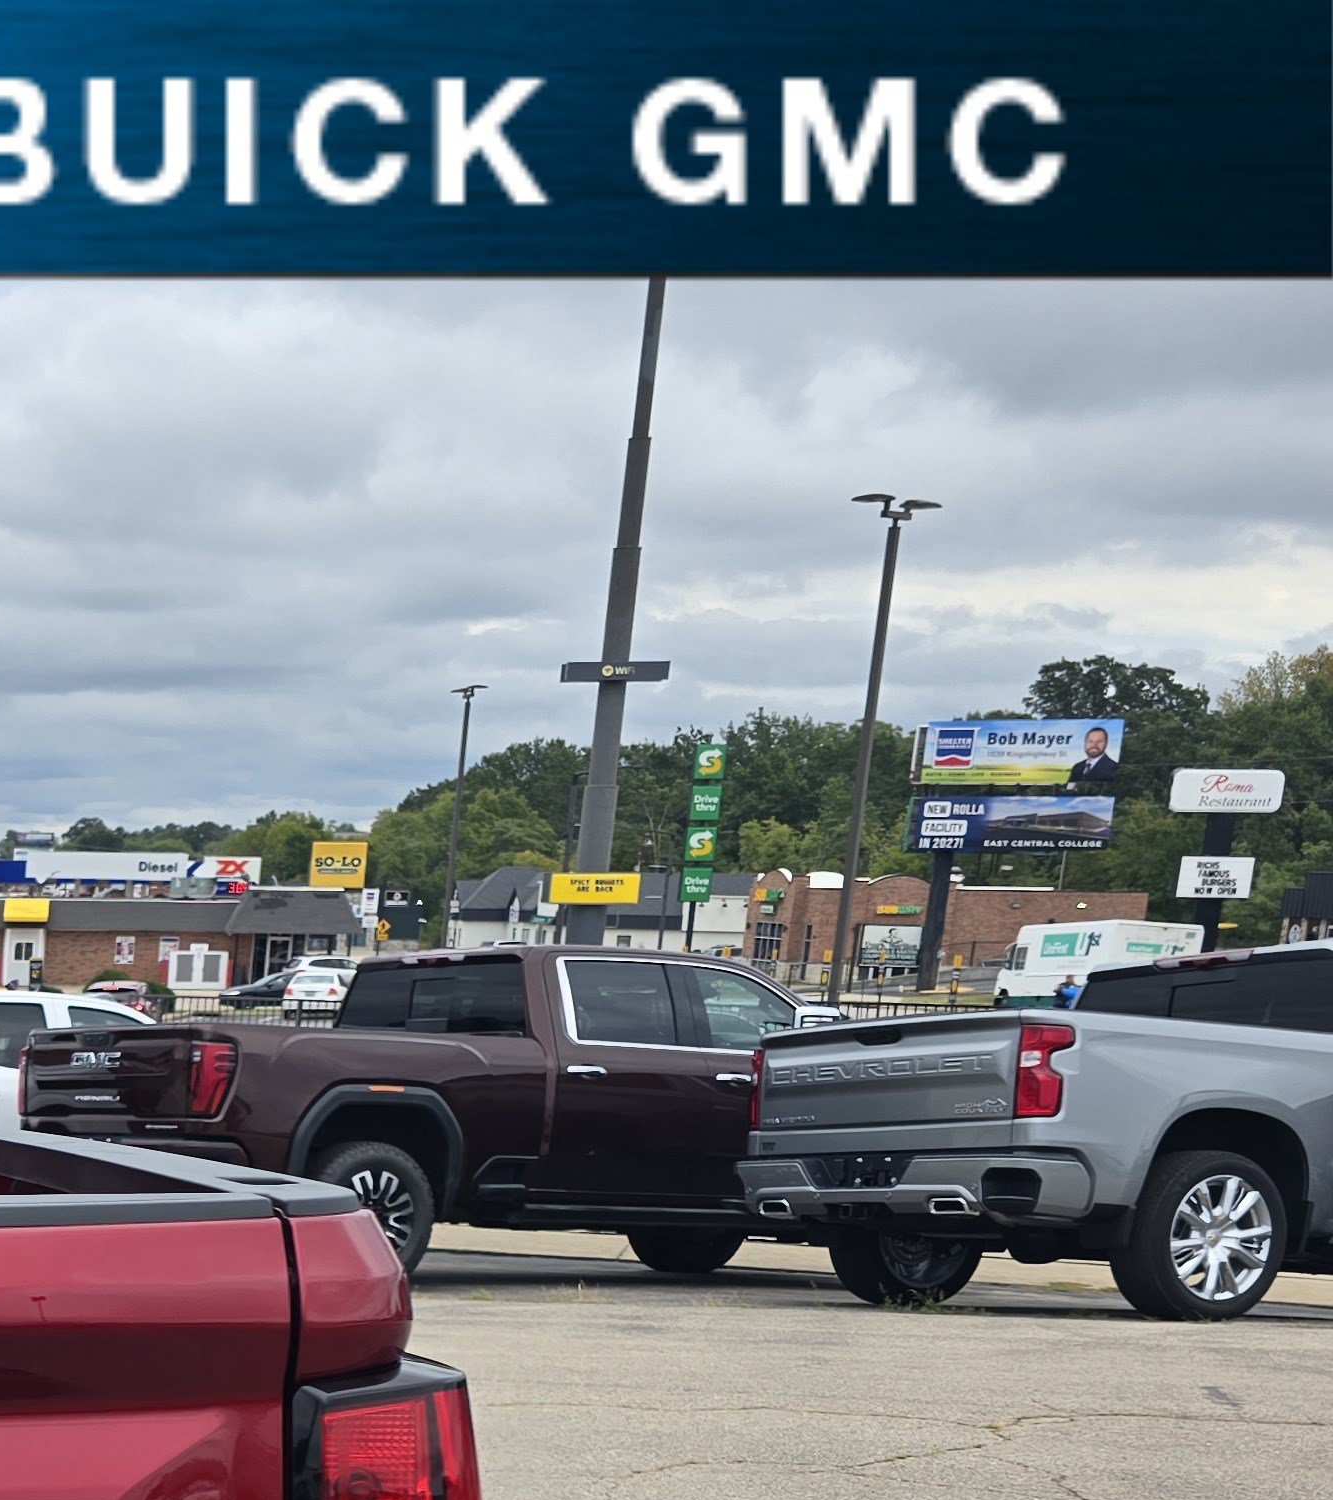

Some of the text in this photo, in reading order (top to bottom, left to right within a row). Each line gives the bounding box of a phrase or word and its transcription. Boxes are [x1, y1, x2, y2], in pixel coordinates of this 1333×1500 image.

[986, 732, 1073, 748] Bob Mayer
[1201, 774, 1254, 793] Roma
[694, 793, 719, 805] Drive
[1198, 796, 1271, 807] Restaurant
[696, 803, 715, 812] thru
[927, 803, 985, 815] NEW ROLLA
[924, 822, 963, 832] FACILITY
[918, 838, 930, 848] IN
[983, 839, 1102, 848] EAST CENTRAL COLLEGE
[139, 861, 177, 872] Diesel
[315, 856, 361, 867] SO-LO
[684, 876, 709, 888] Drive
[686, 884, 706, 893] thru
[71, 1052, 121, 1068] GMC
[771, 1055, 992, 1085] CHEVROLET
